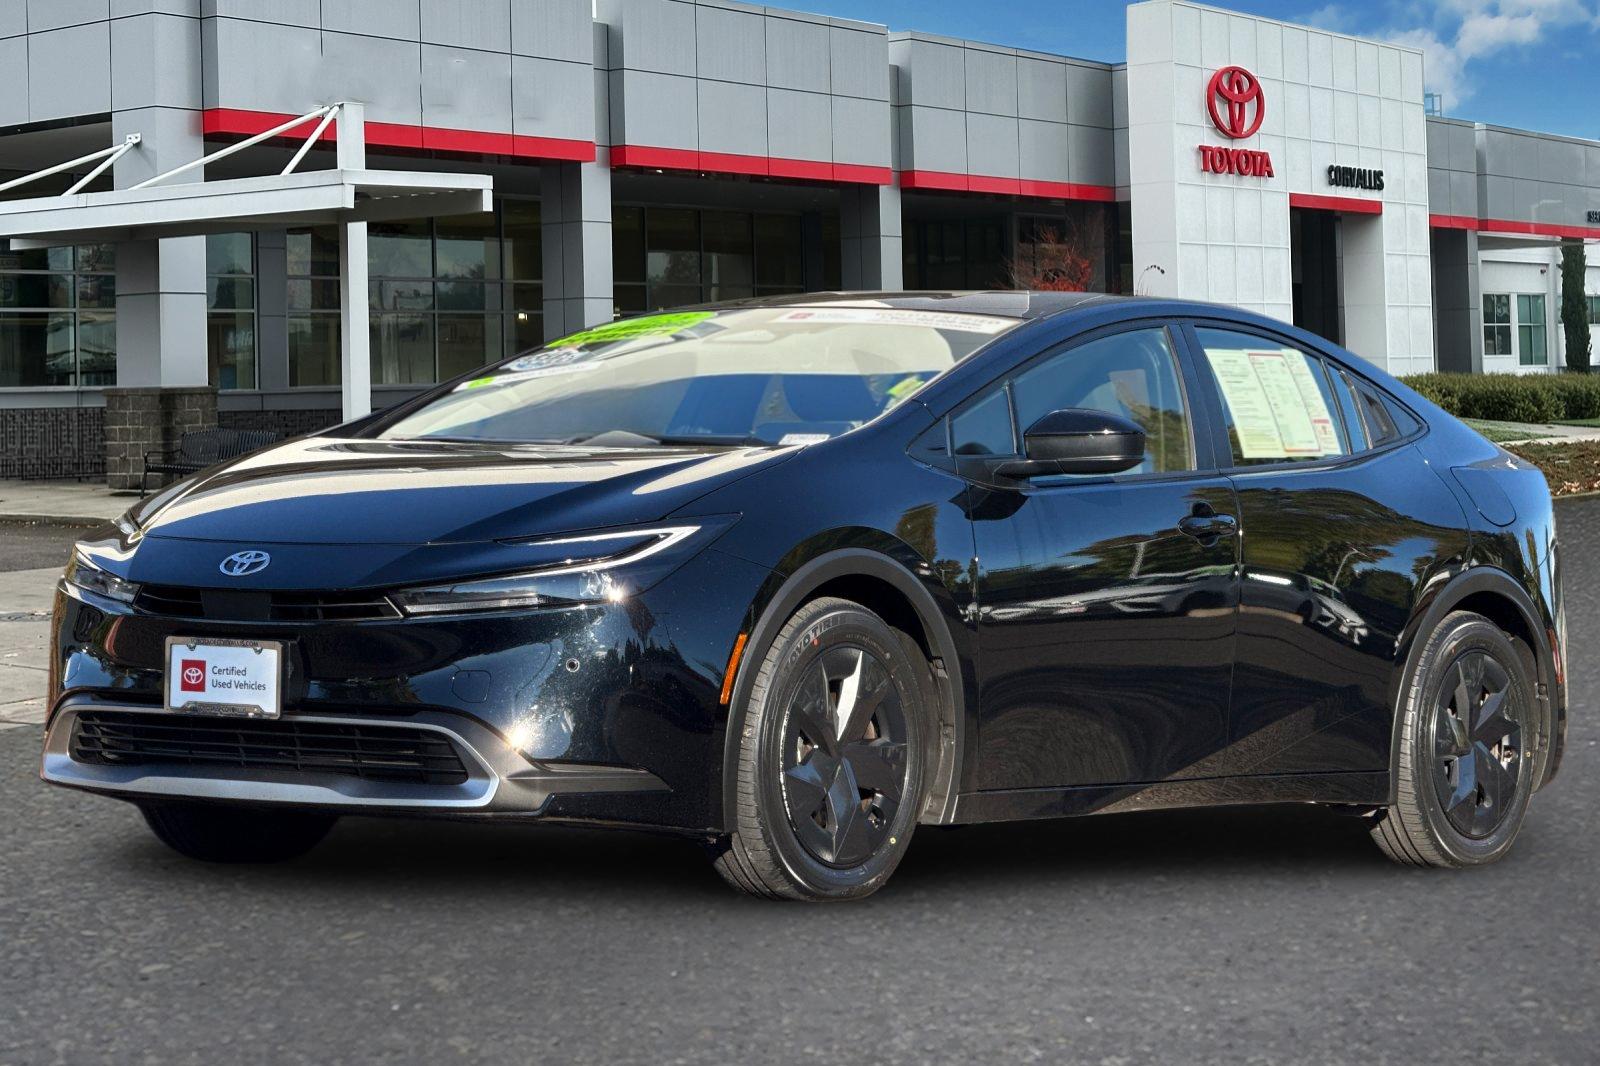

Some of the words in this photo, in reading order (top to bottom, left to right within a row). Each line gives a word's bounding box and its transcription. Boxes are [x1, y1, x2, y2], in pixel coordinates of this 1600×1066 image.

[1198, 145, 1275, 178] TOYOTA
[1327, 164, 1385, 191] CORVALLIS
[211, 665, 247, 677] Certified
[211, 679, 232, 689] Used
[233, 680, 266, 691] Vehicles
